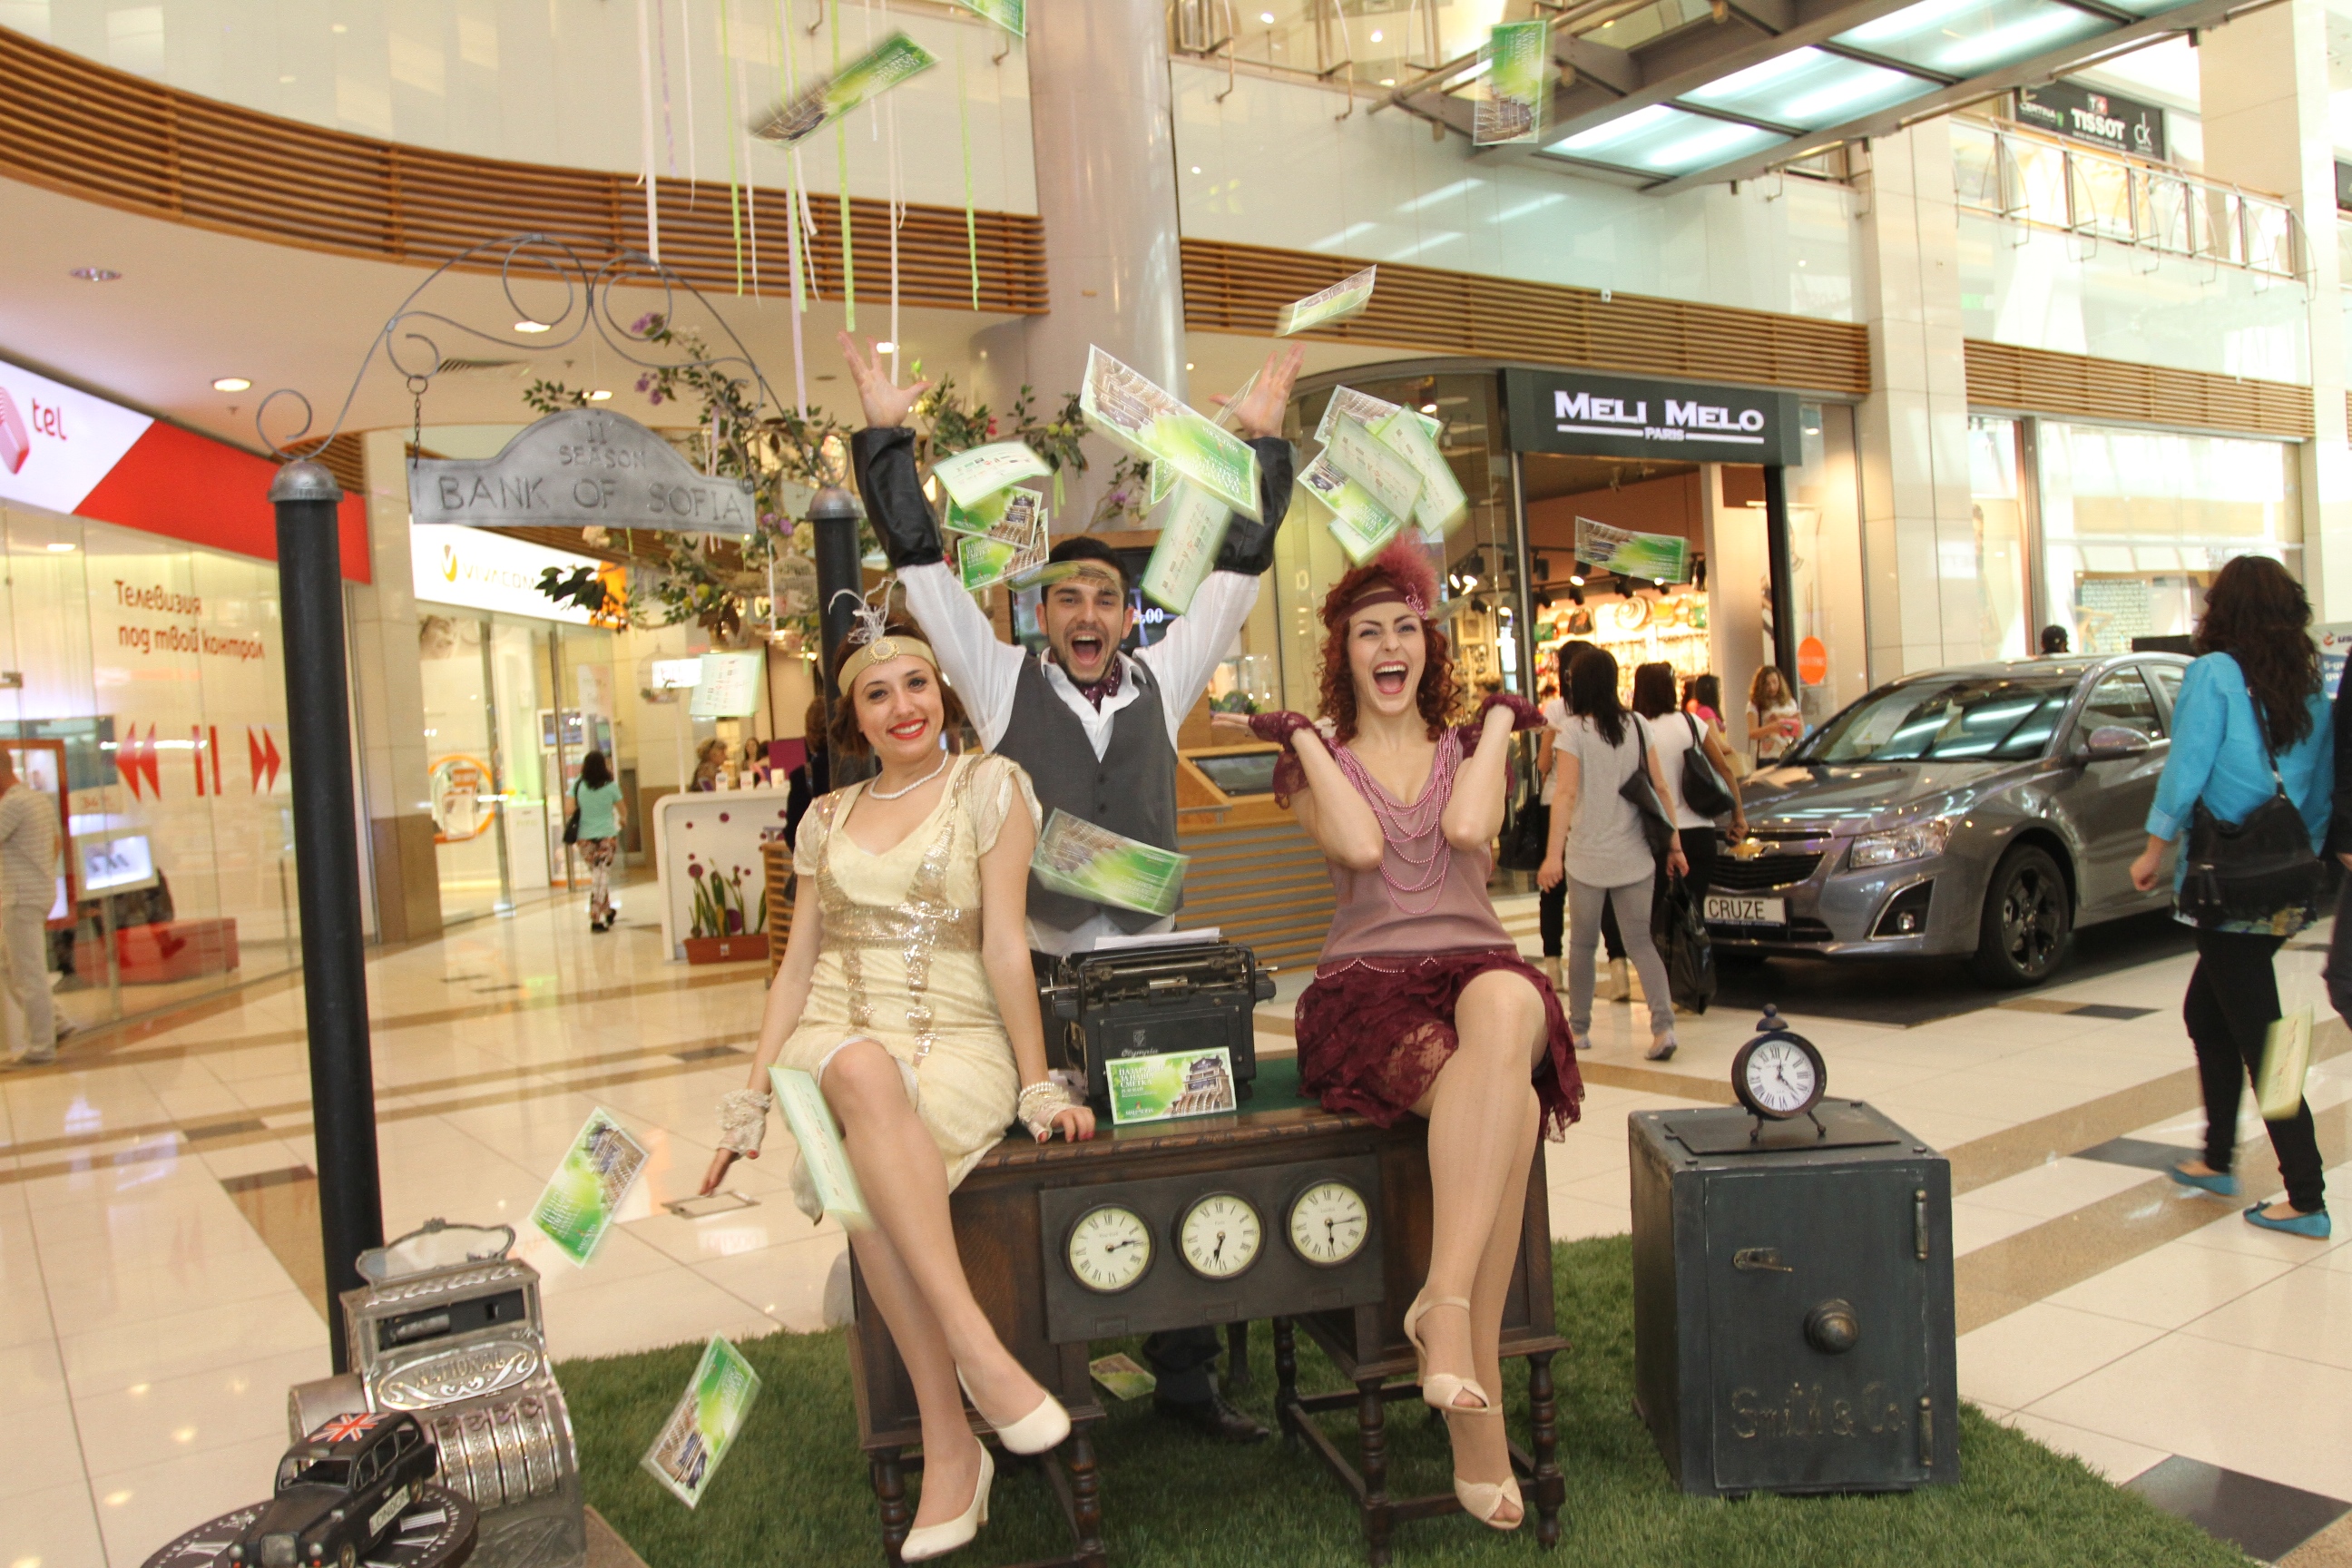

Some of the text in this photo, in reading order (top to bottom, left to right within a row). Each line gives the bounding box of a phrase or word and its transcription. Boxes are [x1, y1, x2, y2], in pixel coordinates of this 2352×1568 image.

[2071, 107, 2125, 141] TISSOT
[32, 397, 67, 441] tel
[1554, 390, 1764, 432] MELI MELO
[1644, 426, 1685, 442] PARIS
[559, 445, 646, 469] SEASON
[438, 475, 743, 522] BANK OF SOFIA
[463, 563, 535, 590] VIVACOM
[114, 579, 202, 615] Телевизия
[1709, 898, 1765, 920] CRUZE
[412, 1351, 506, 1388] NATIONAL
